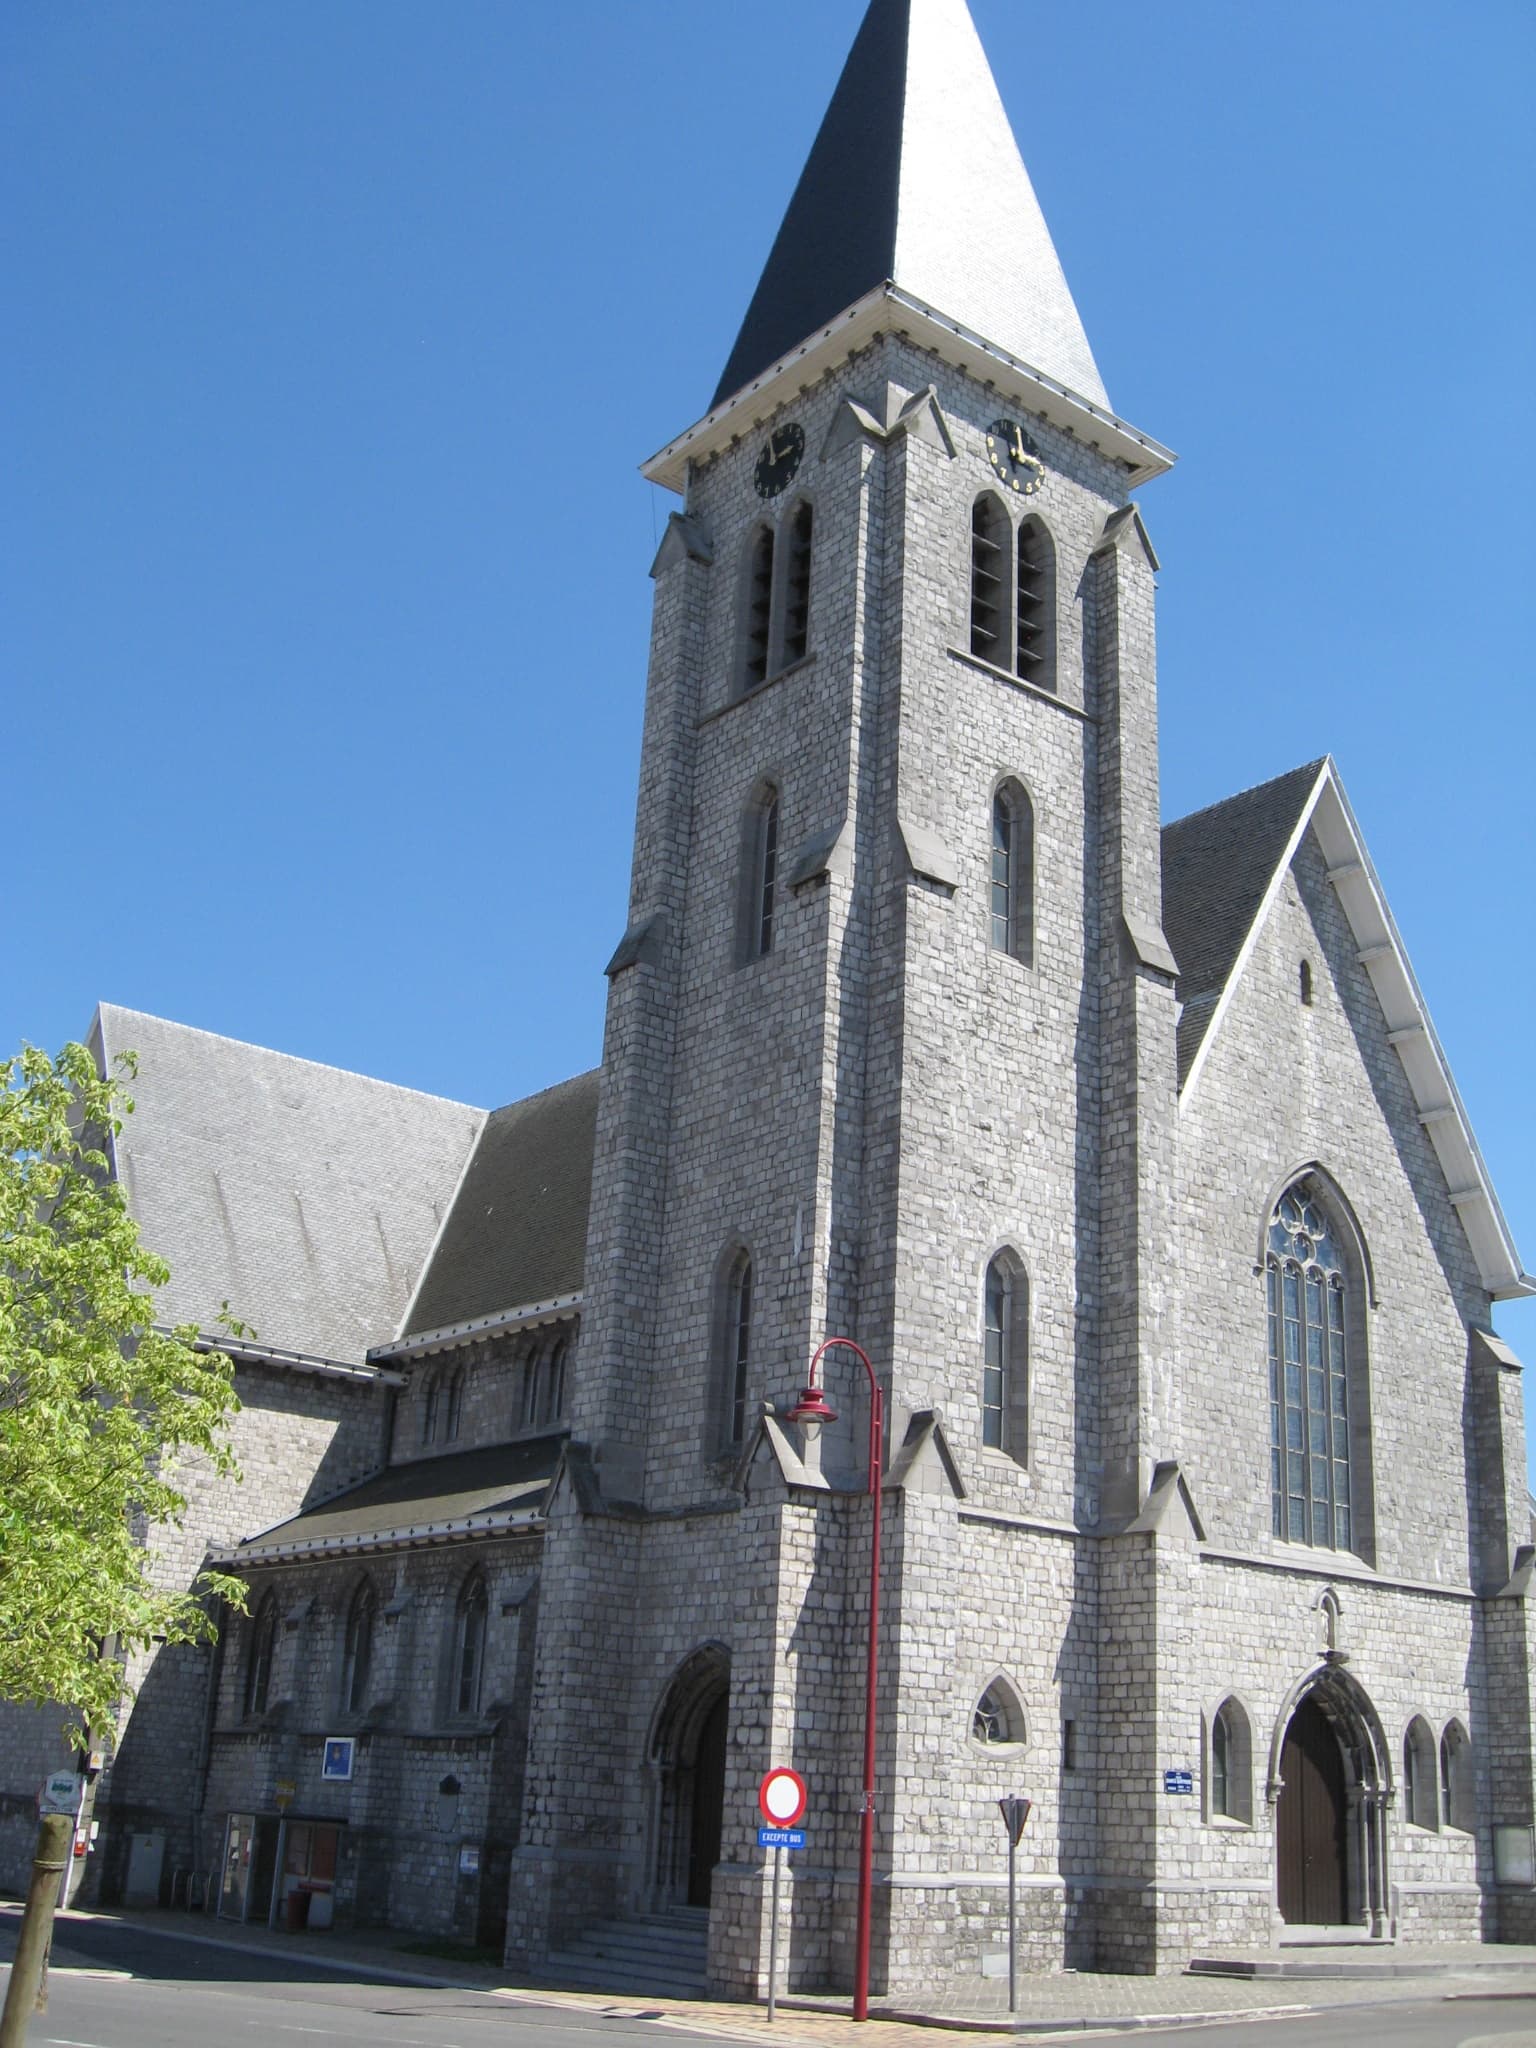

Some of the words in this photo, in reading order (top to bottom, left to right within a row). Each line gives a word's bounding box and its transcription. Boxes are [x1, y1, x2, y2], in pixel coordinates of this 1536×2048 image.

[1000, 466, 1008, 479] 7
[1039, 464, 1046, 477] 3
[1025, 482, 1033, 493] 5
[1034, 477, 1041, 489] 4
[790, 1834, 801, 1843] BUS
